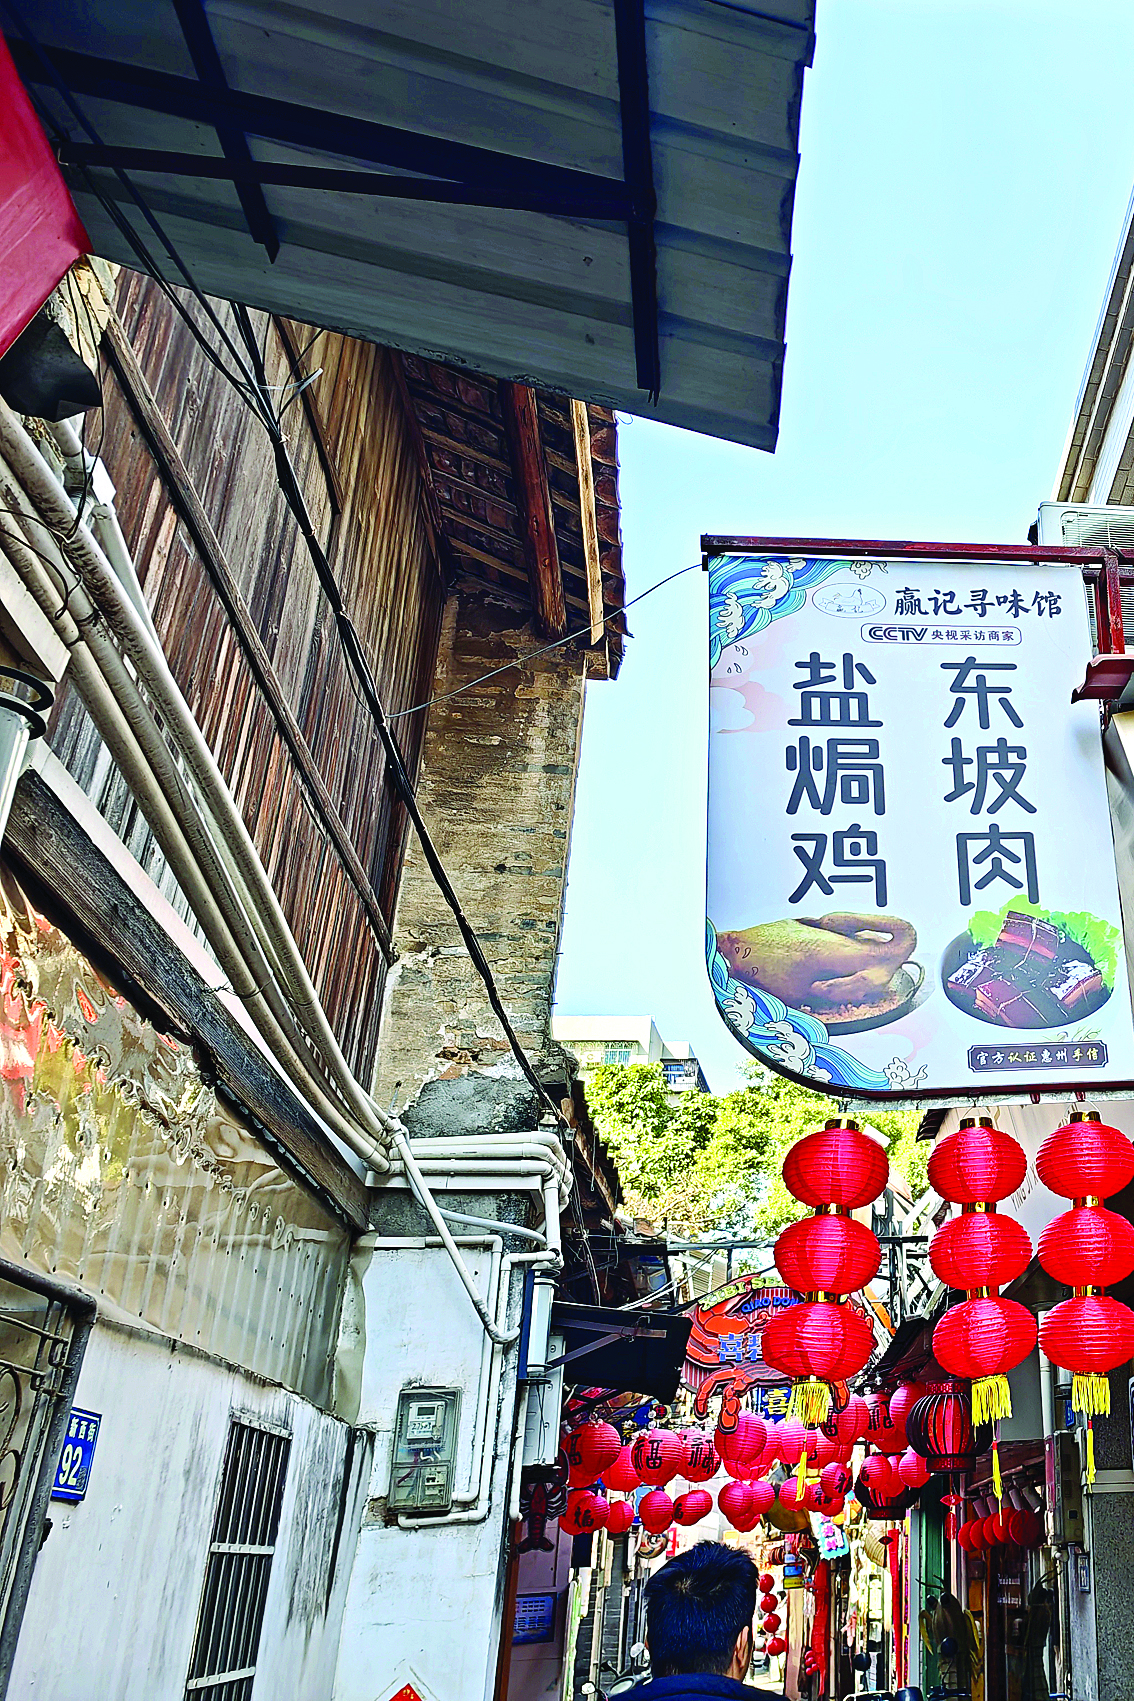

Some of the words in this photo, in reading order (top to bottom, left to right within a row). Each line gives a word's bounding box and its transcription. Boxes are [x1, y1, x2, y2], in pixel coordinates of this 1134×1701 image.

[894, 587, 1062, 618] 赢记寻味馆
[868, 626, 928, 642] CCTV
[931, 629, 1015, 642] 央视采访商家
[786, 652, 888, 908] 盐焗鸡
[940, 656, 1040, 907] 东坡肉
[976, 1047, 1099, 1066] 官方认证惠州手信
[741, 1297, 771, 1313] QIAO
[772, 1296, 800, 1306] DON
[58, 1443, 83, 1486] 92
[634, 1439, 664, 1471] 福
